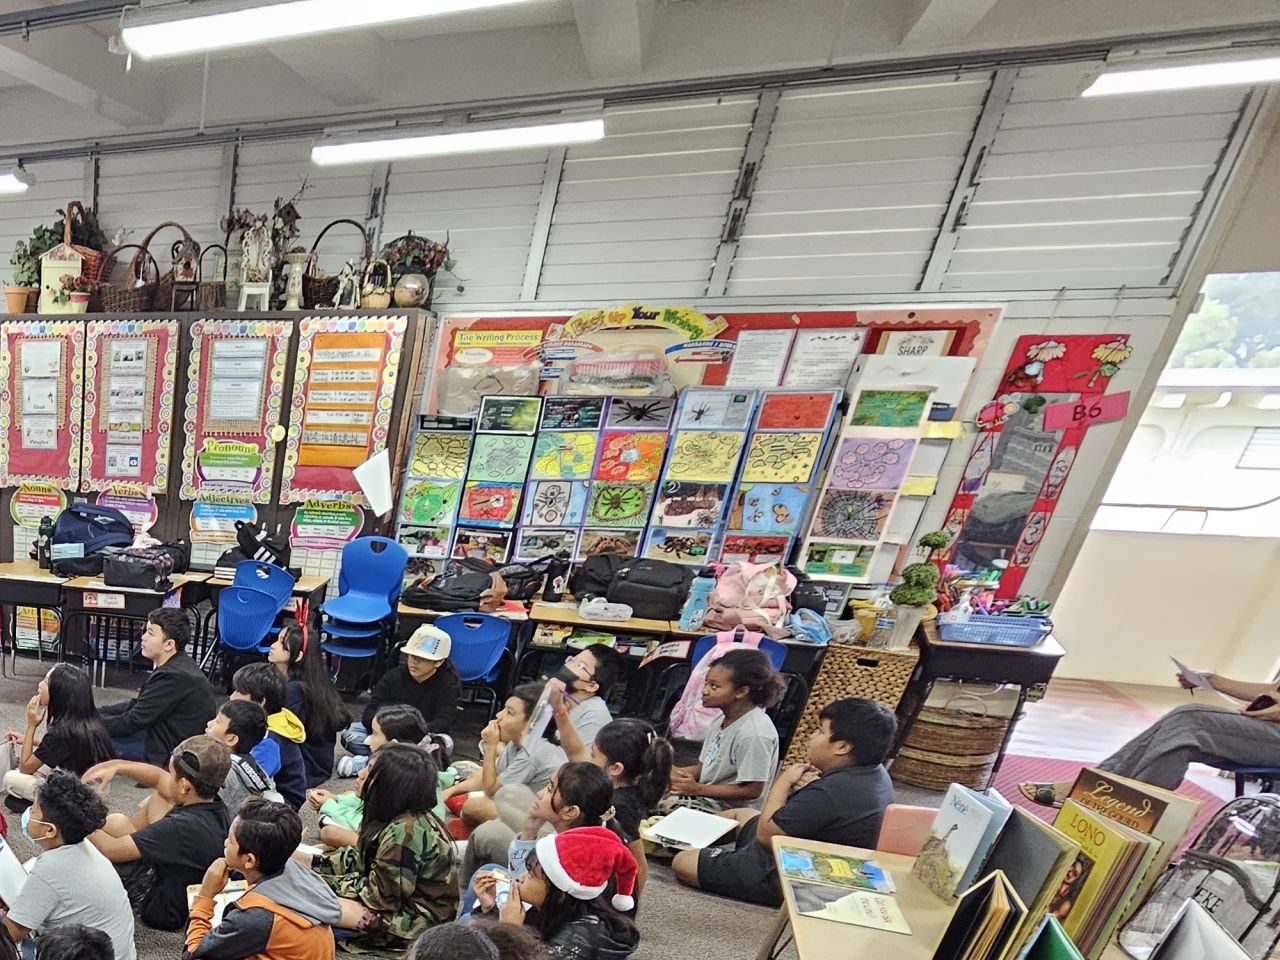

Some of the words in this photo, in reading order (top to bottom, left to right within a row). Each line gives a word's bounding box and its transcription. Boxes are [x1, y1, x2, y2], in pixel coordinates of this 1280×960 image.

[631, 306, 661, 321] Your
[475, 333, 504, 343] Writing
[897, 345, 928, 356] SHARP
[1072, 402, 1103, 421] B6
[206, 440, 257, 453] Pronouns
[22, 484, 52, 494] Nouns
[112, 484, 140, 496] Verbs
[198, 493, 250, 504] Adjectives
[306, 499, 353, 510] Adverbs
[1083, 780, 1153, 818] Legend
[1070, 813, 1106, 847] LONO
